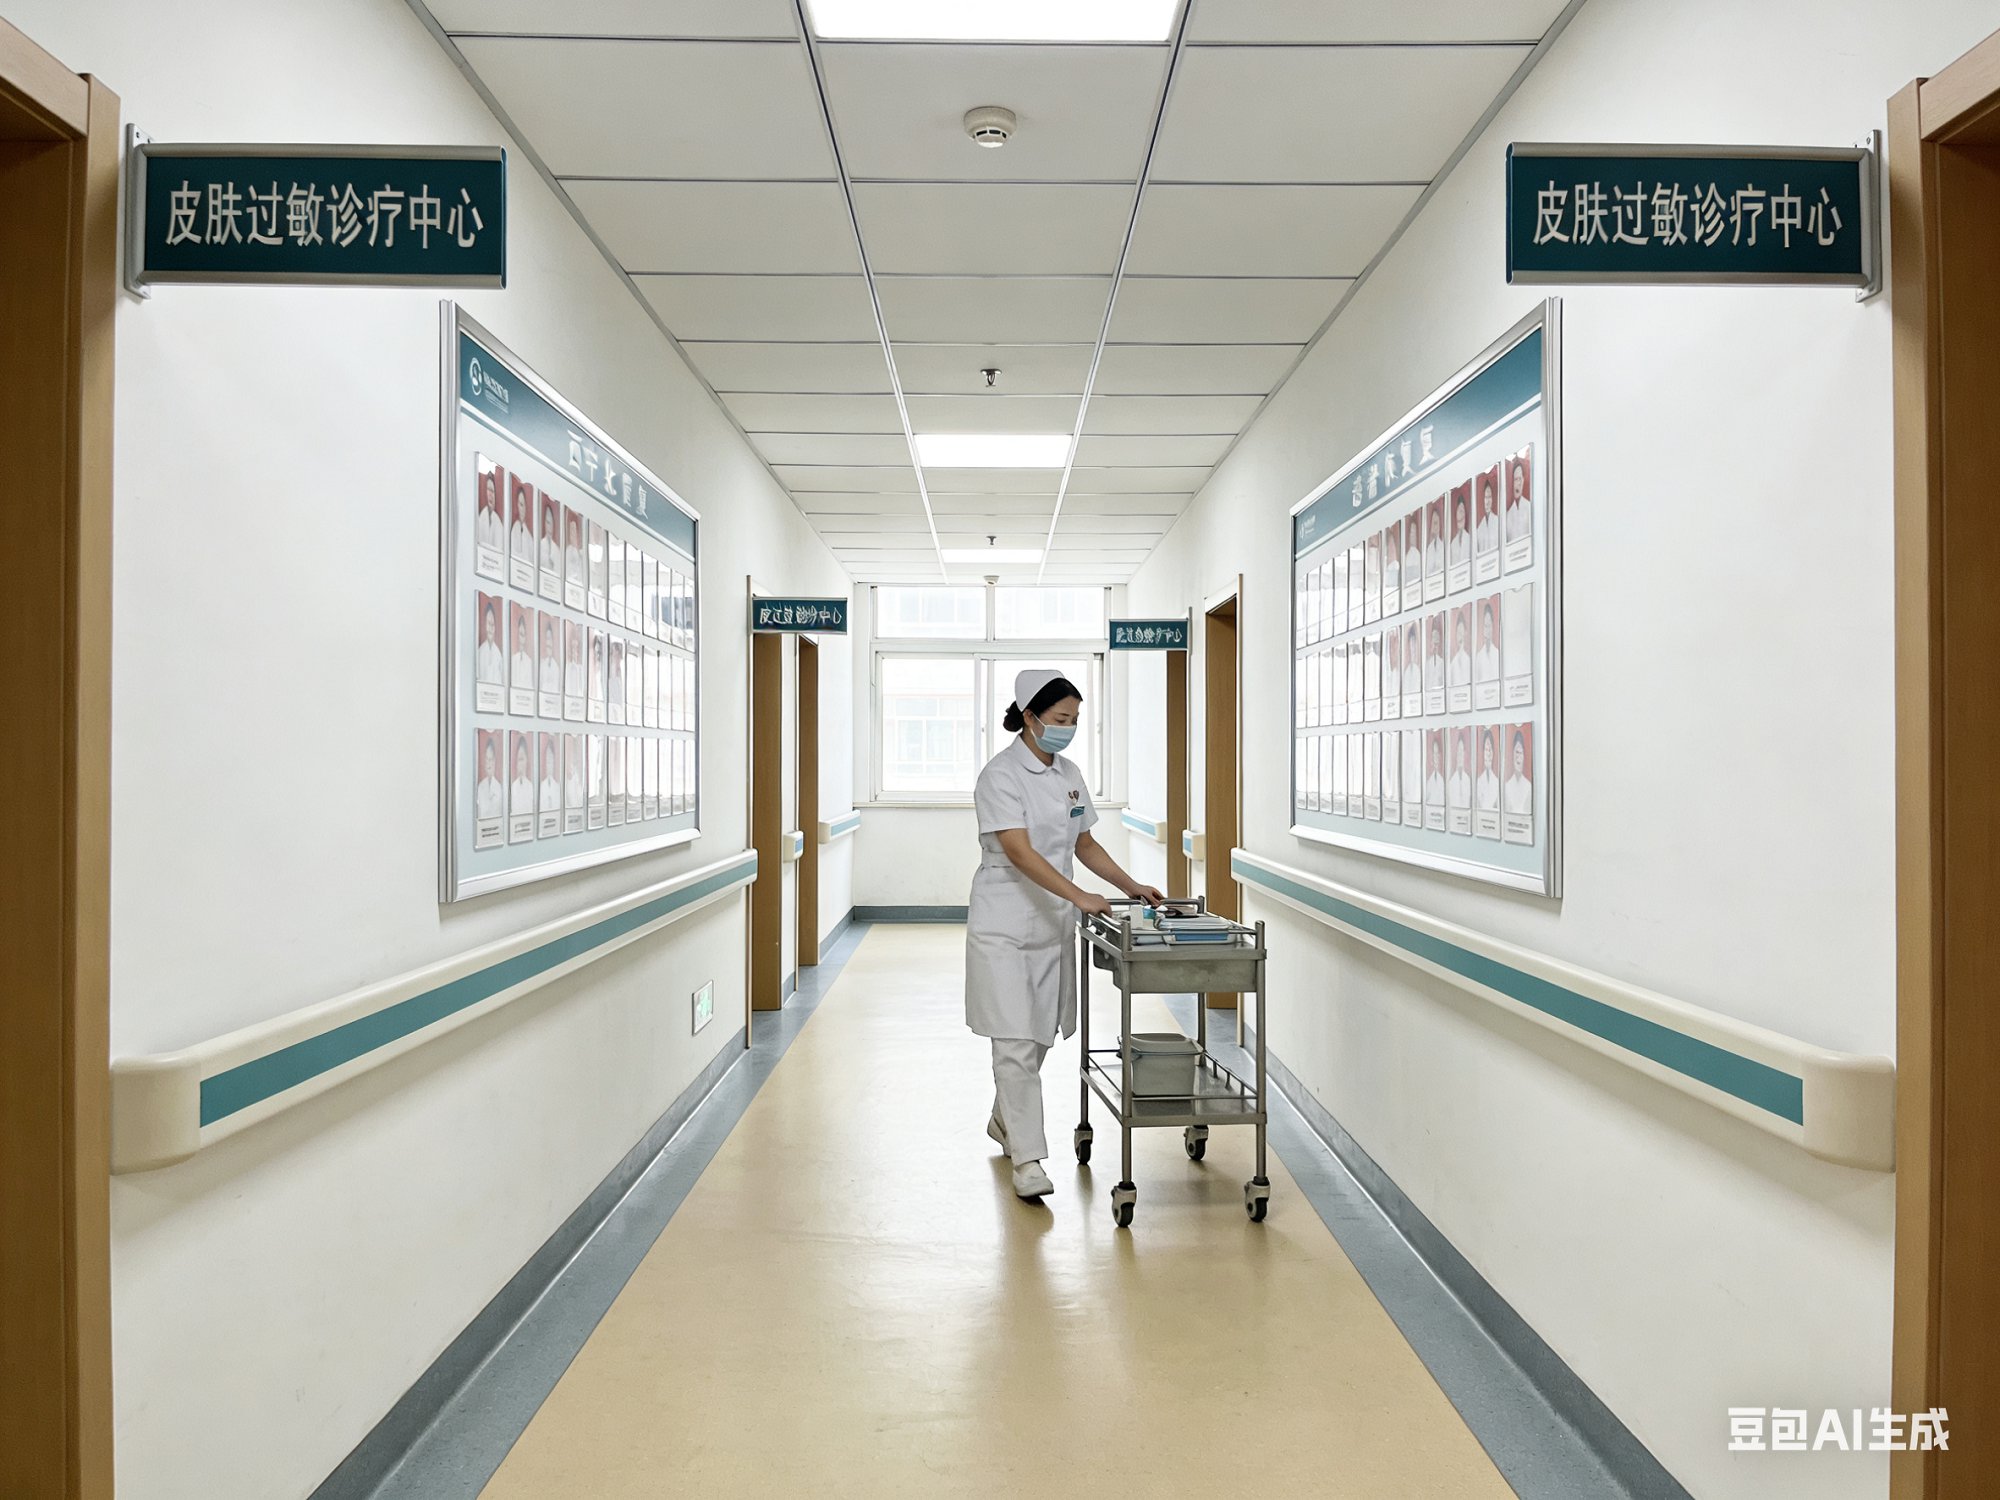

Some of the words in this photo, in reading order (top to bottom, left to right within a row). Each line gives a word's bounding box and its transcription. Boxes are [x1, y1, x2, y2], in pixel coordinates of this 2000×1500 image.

[166, 180, 484, 249] 皮肤过敏诊疗中心
[1533, 180, 1842, 248] 皮肤过敏诊疗中心
